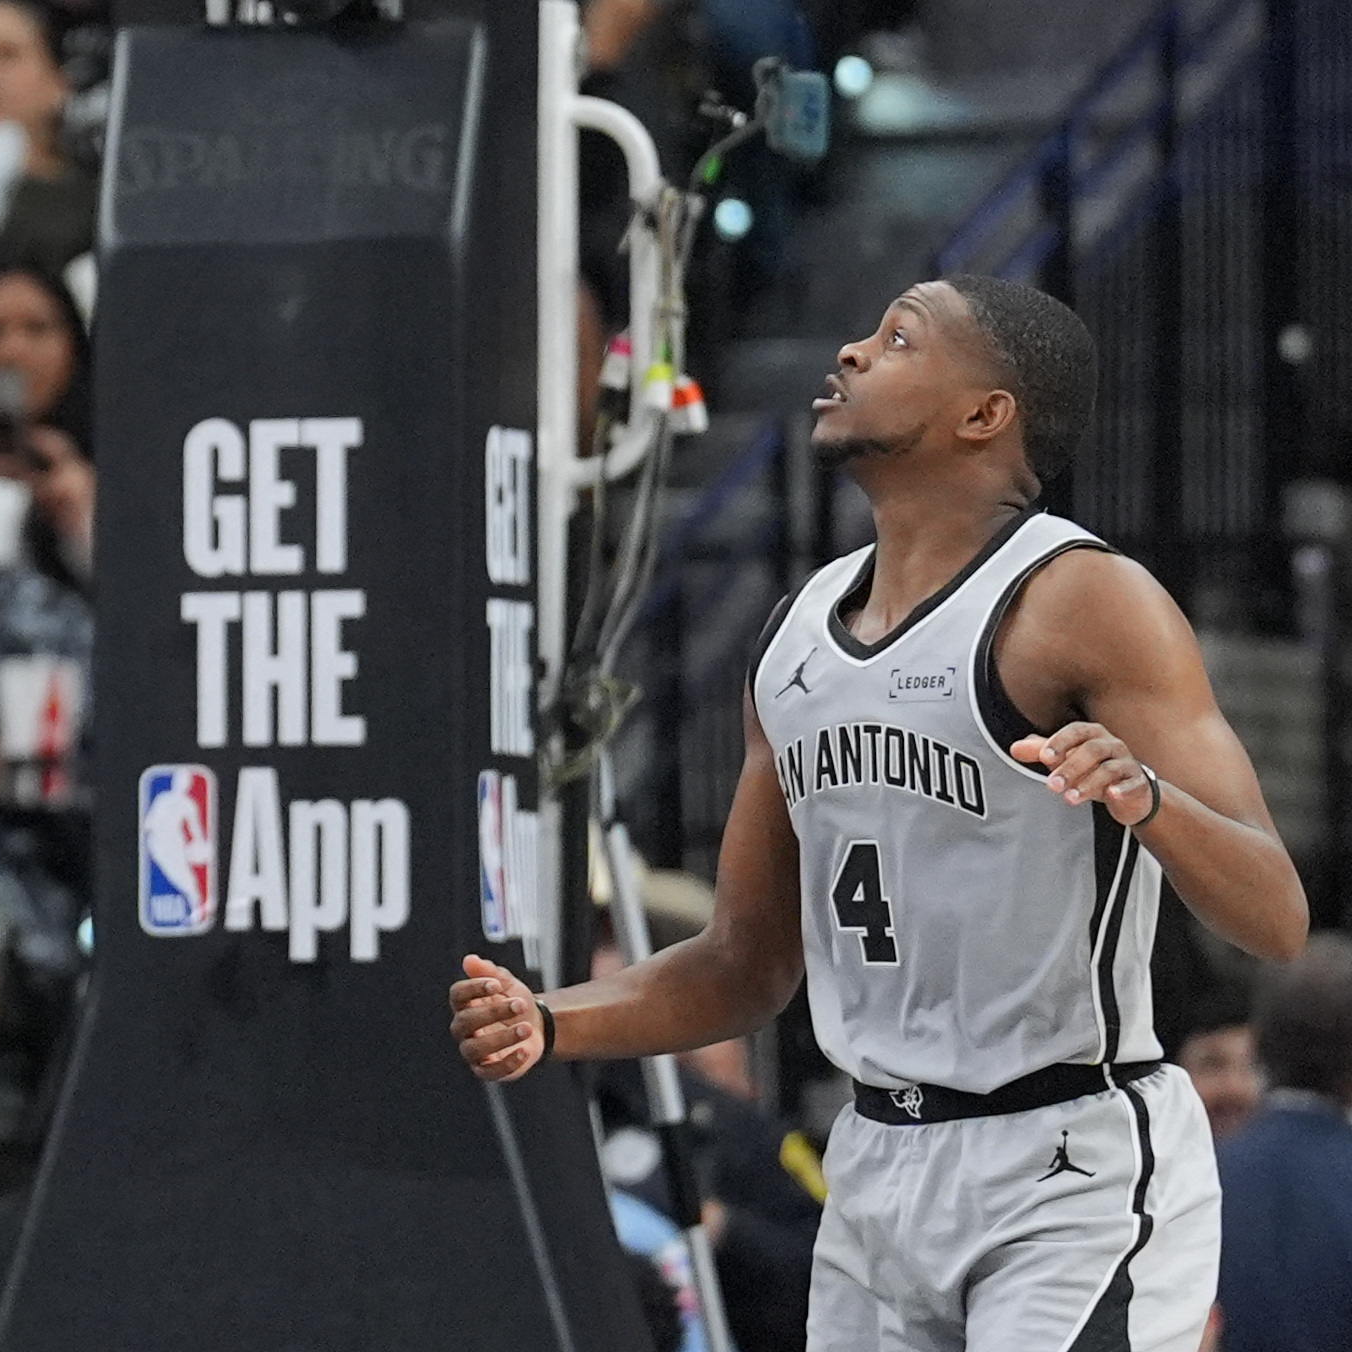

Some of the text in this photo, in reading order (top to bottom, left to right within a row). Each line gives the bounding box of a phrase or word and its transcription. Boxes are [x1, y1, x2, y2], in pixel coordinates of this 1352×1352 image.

[183, 417, 363, 578] GET
[485, 425, 533, 585] GET
[181, 590, 366, 748] THE
[897, 675, 946, 690] LEDGER
[814, 722, 987, 820] ANTONIO
[225, 766, 410, 962] App
[829, 839, 900, 966] 4
